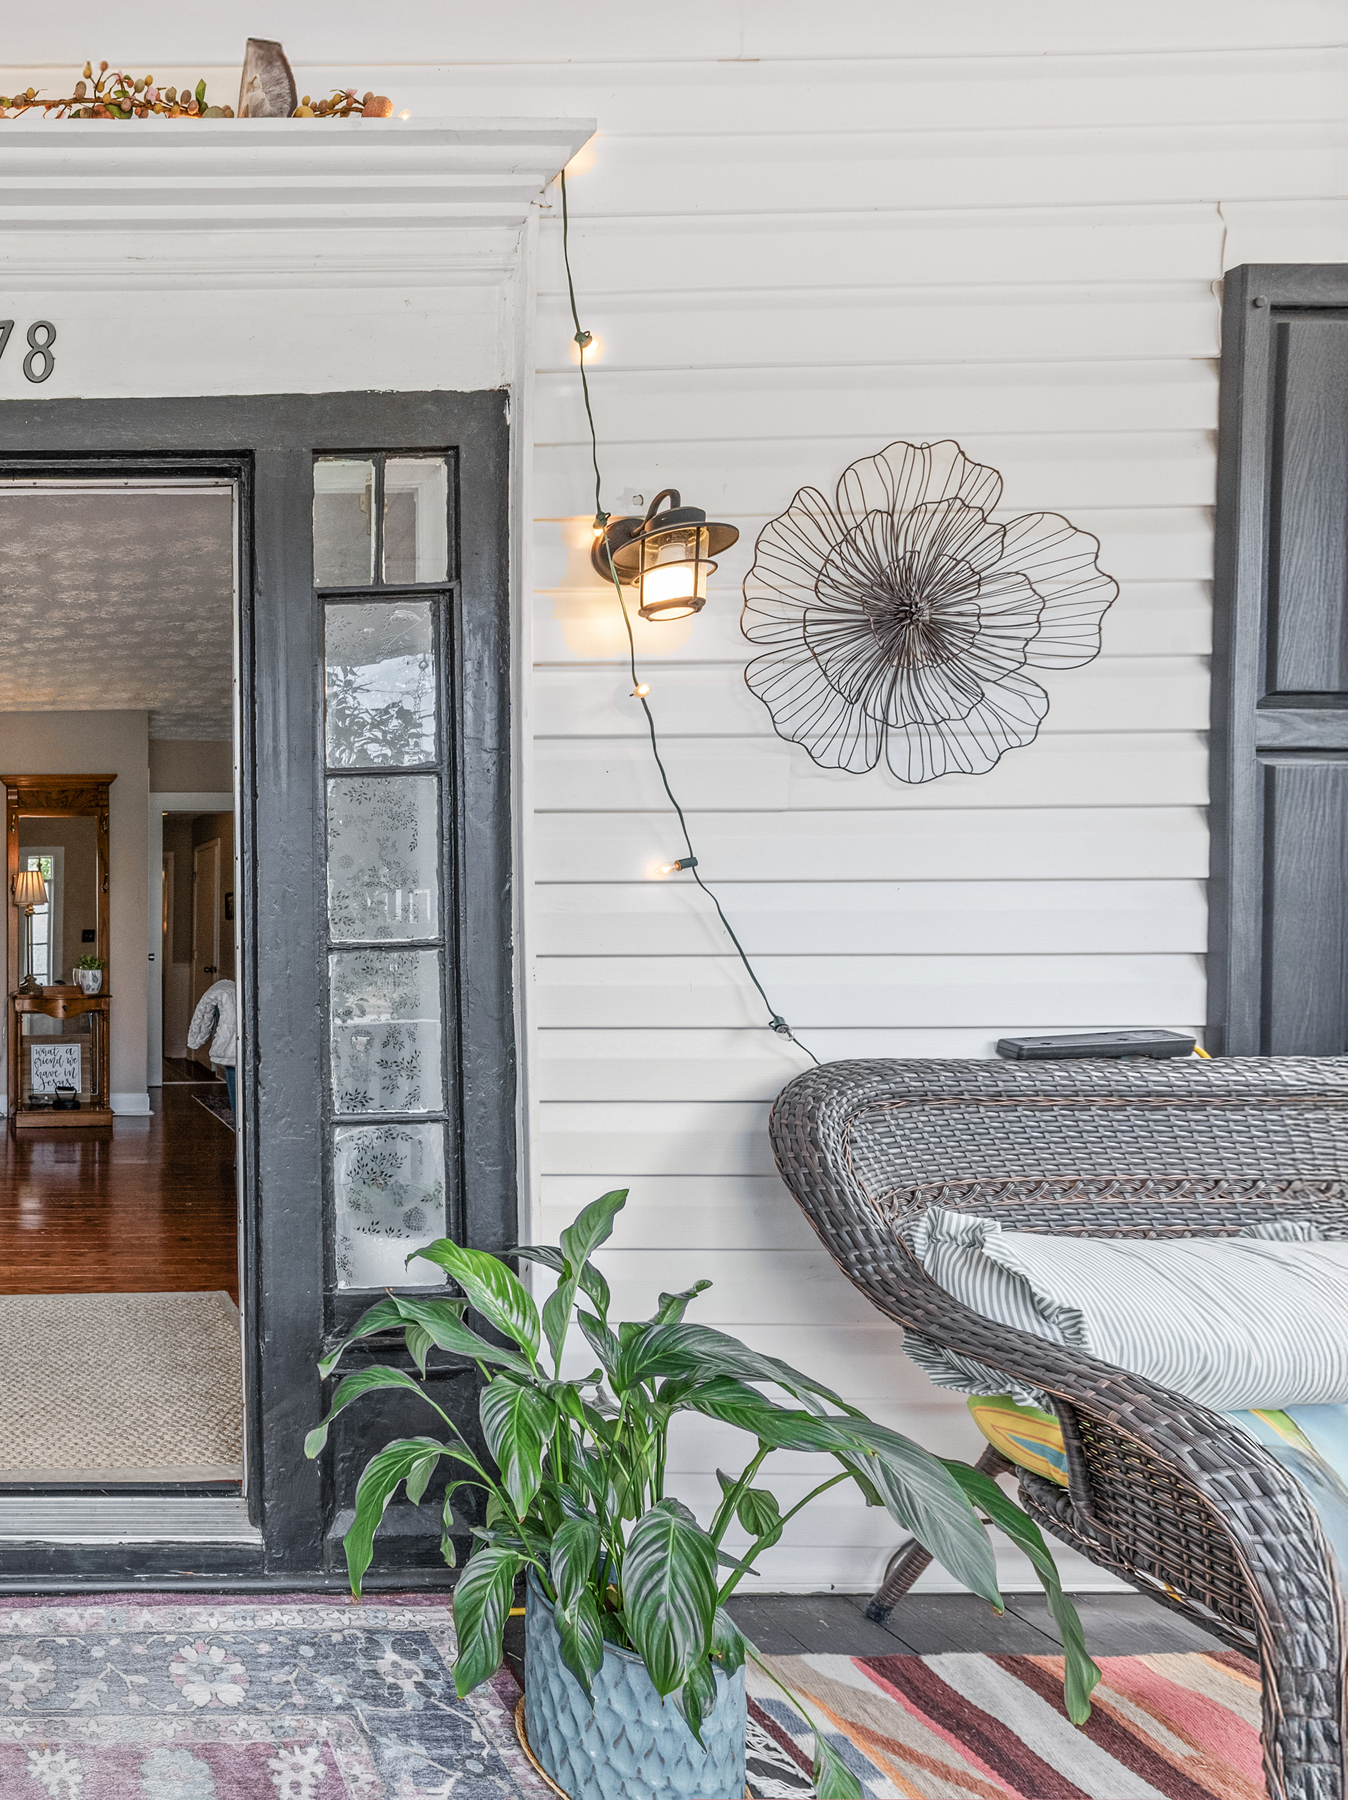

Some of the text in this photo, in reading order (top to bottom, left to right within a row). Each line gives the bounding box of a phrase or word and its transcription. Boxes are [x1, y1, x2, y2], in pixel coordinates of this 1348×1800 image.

[35, 1047, 76, 1056] what a
[34, 1055, 78, 1069] friend we
[35, 1067, 78, 1079] have in
